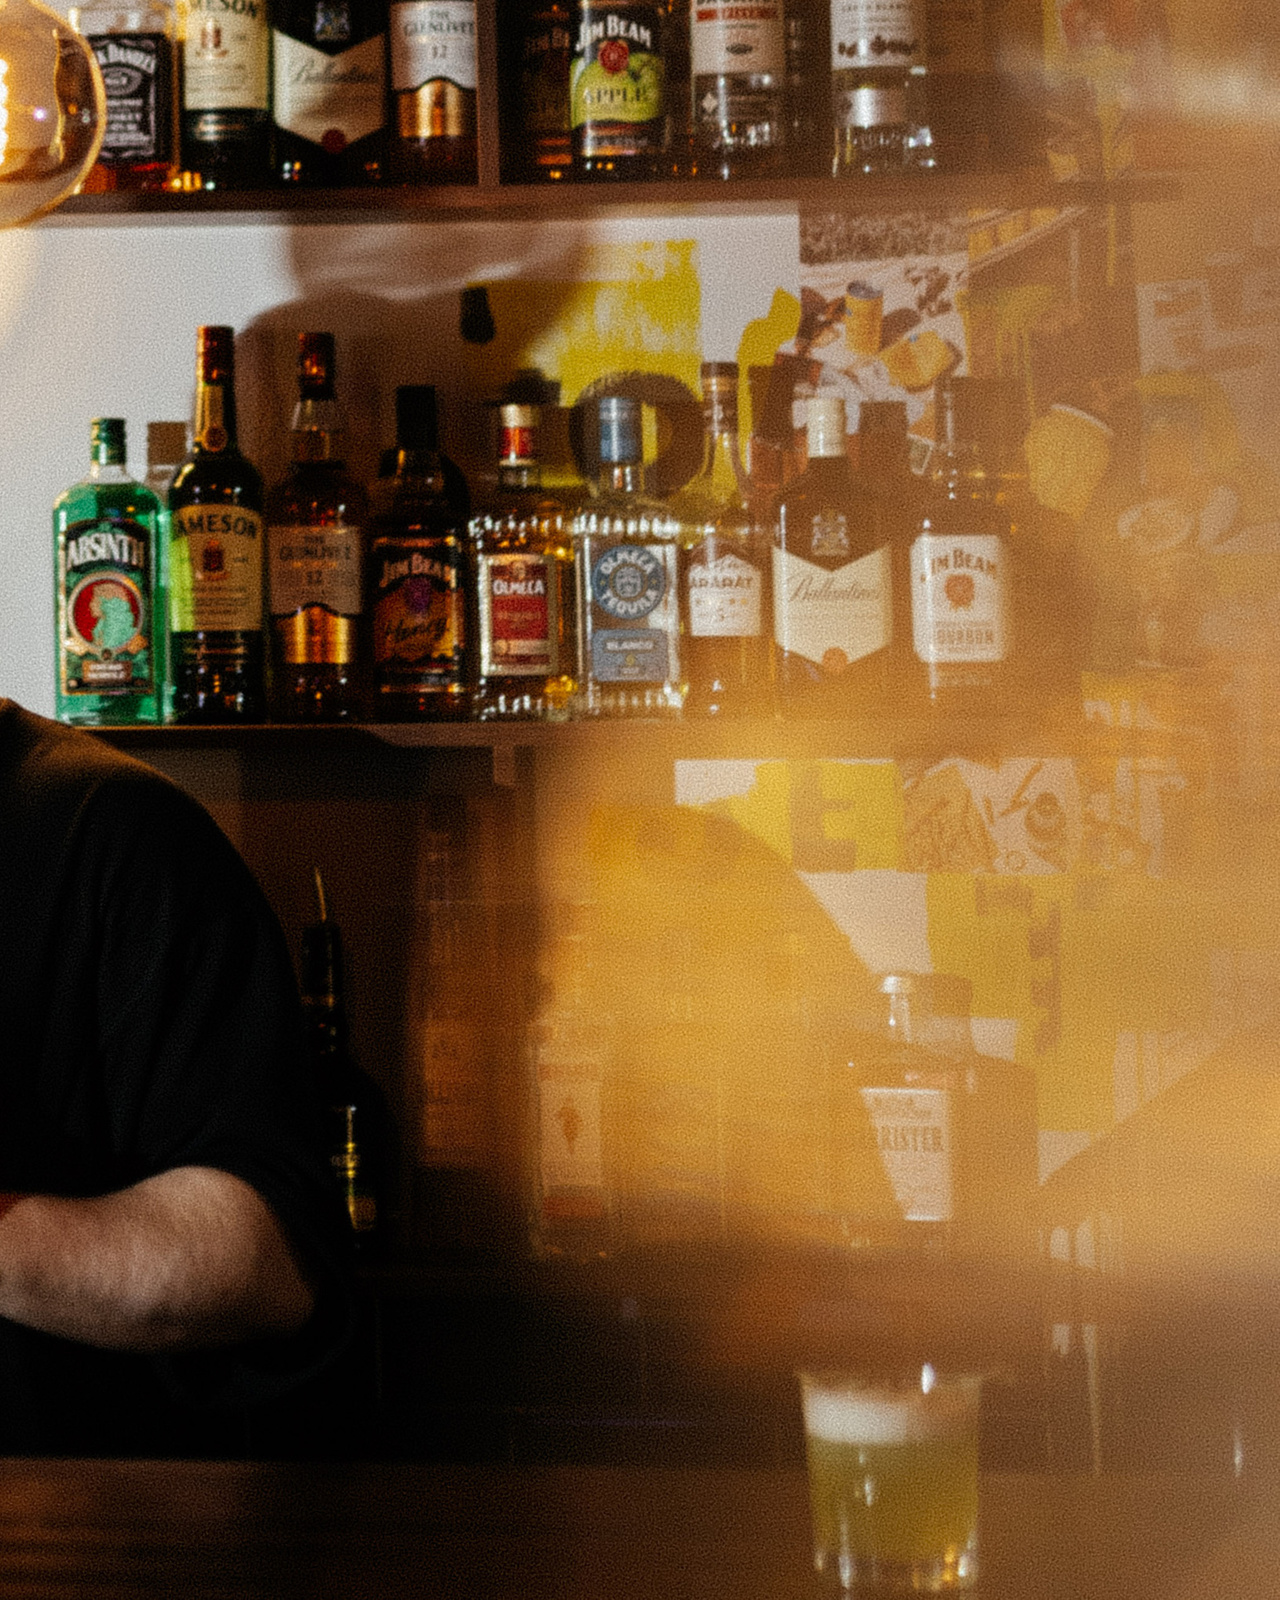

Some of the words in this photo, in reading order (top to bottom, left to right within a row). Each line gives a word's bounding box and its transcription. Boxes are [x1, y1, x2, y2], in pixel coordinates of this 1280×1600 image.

[576, 20, 604, 52] JIM
[606, 13, 652, 49] BEAM
[582, 86, 648, 105] APPLE
[175, 512, 257, 540] AMESON
[599, 549, 656, 577] OLMECA
[953, 547, 998, 580] BEAM
[492, 579, 546, 597] OLMECA
[598, 588, 659, 616] TEQUILA
